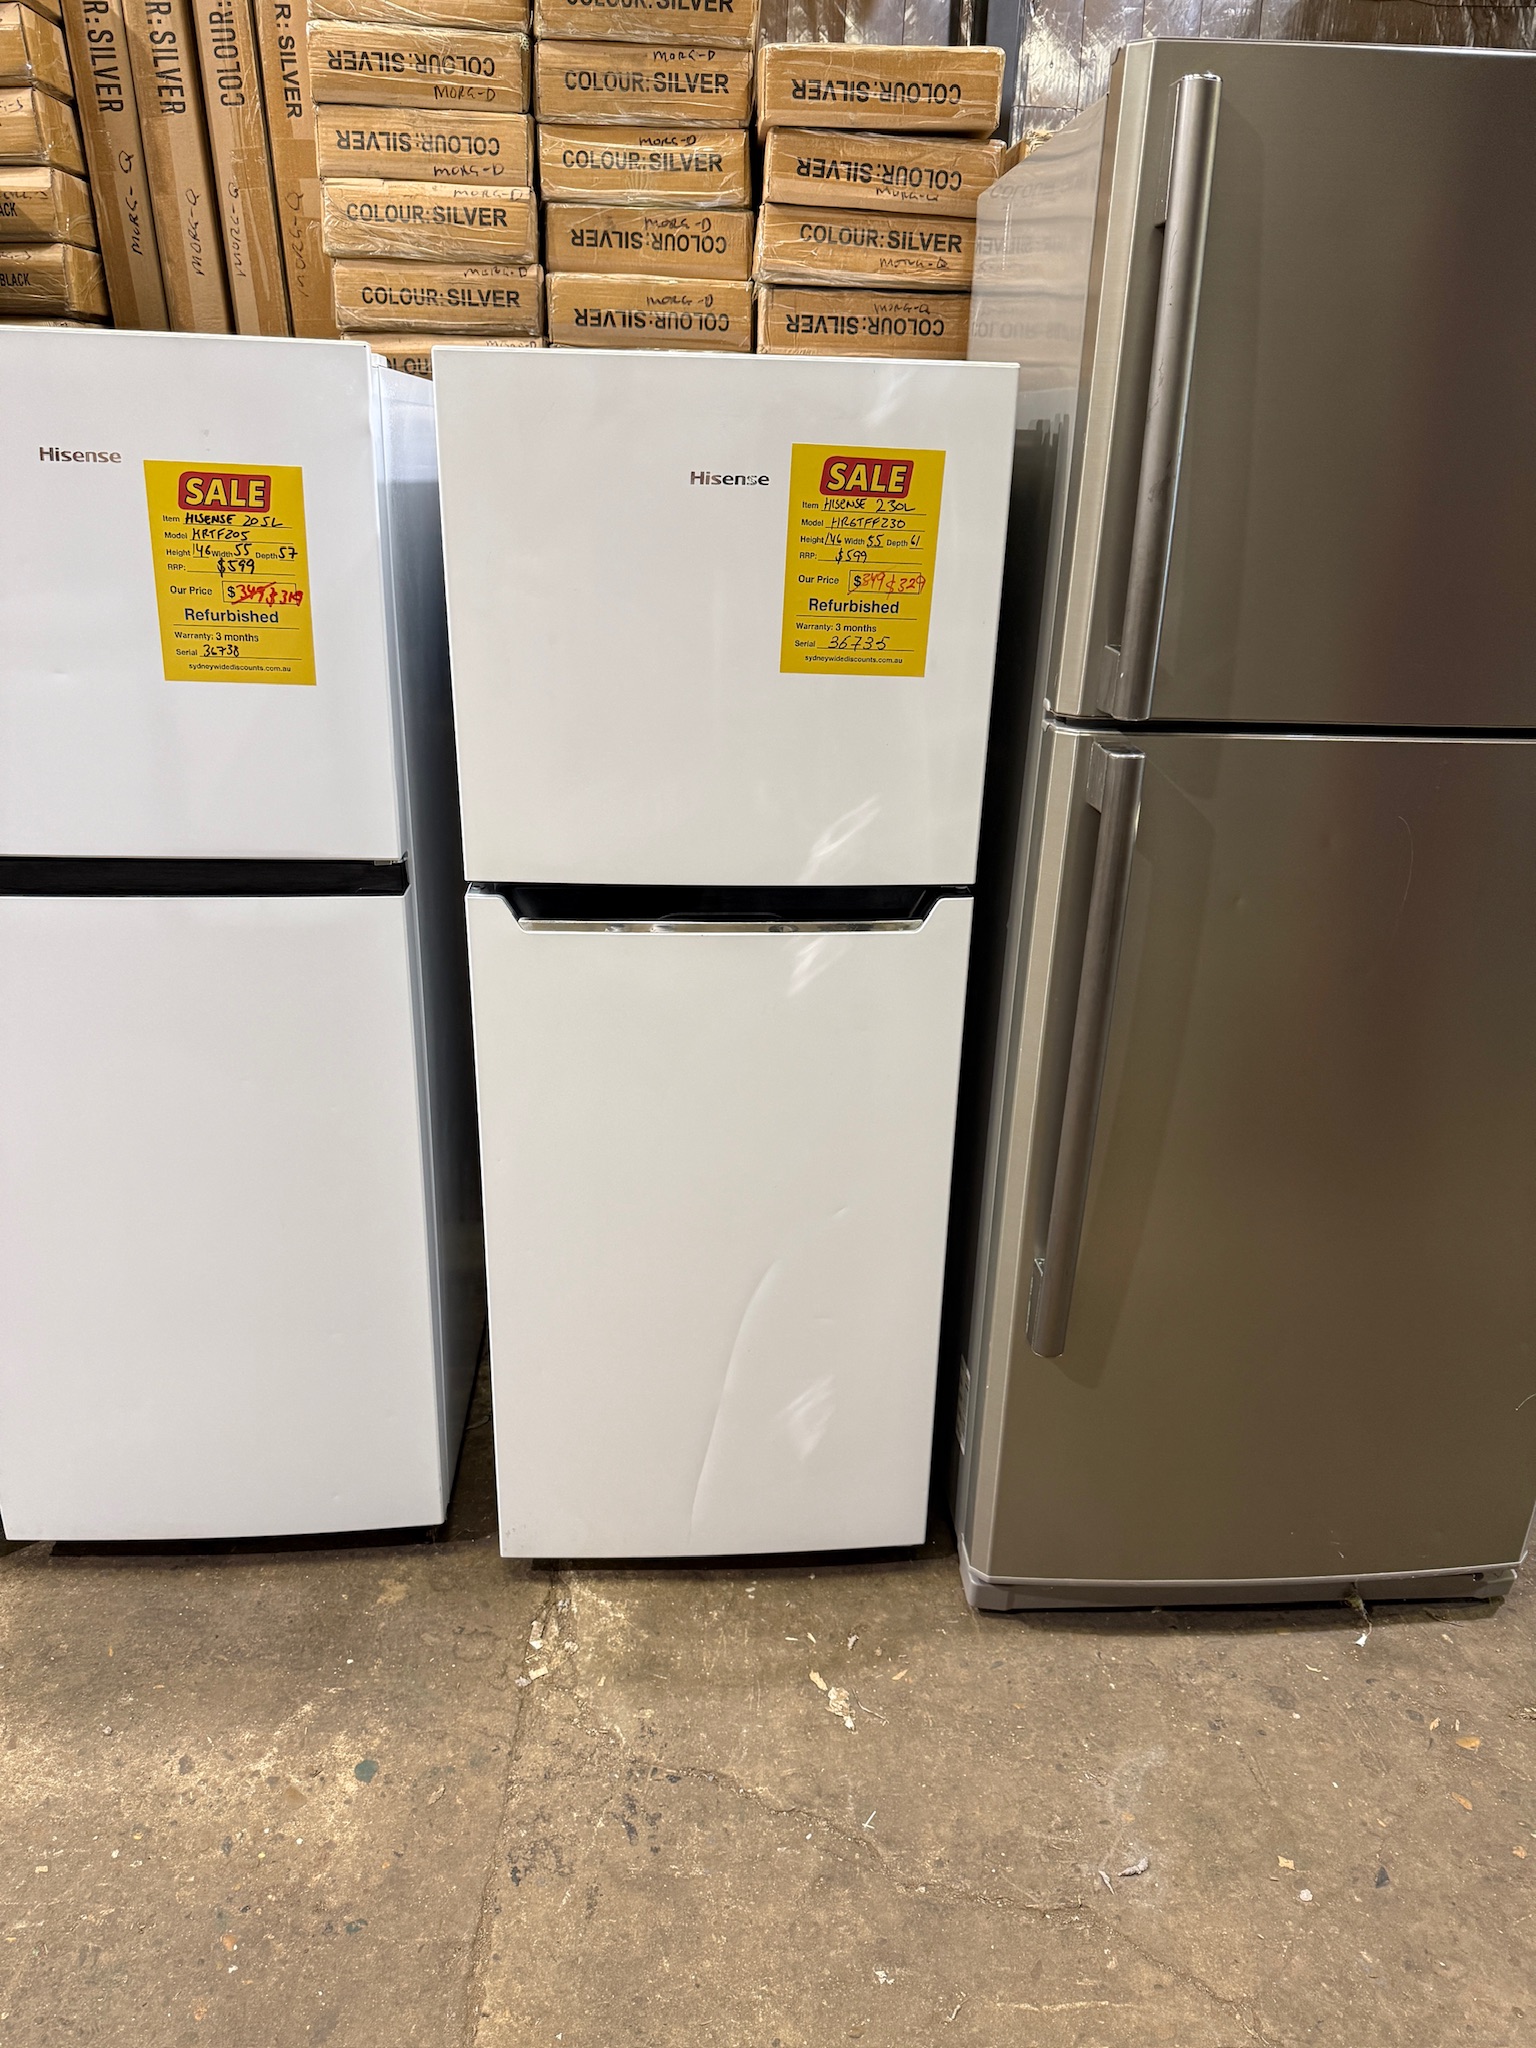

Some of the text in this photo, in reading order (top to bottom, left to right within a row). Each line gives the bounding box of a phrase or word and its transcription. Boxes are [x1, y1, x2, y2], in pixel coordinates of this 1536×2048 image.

[39, 447, 122, 463] Hisense
[690, 471, 770, 486] Hisense
[826, 462, 908, 493] SALE
[185, 477, 266, 508] SALE
[802, 501, 819, 509] Item
[876, 498, 916, 513] 230L
[163, 515, 180, 523] Item
[192, 528, 250, 541] HRTF205
[800, 532, 921, 547] Height 146 Width 55 Depth 61
[166, 543, 298, 560] Height 146 Width 55 Depth 57
[799, 548, 868, 564] RRP: $599
[217, 558, 255, 578] $599
[798, 574, 815, 583] Our
[817, 575, 839, 584] Price
[170, 585, 187, 594] Our
[189, 586, 212, 596] Price
[809, 598, 900, 614] Refurbished
[184, 608, 279, 623] Refurbished
[796, 622, 877, 633] Warranty: 3 months
[174, 631, 259, 642] Warranty: 3 months
[828, 635, 890, 651] 36735
[805, 655, 903, 664] sydneywidediscounts.com.au
[189, 663, 291, 672] sydneywidediscounts.com.au
